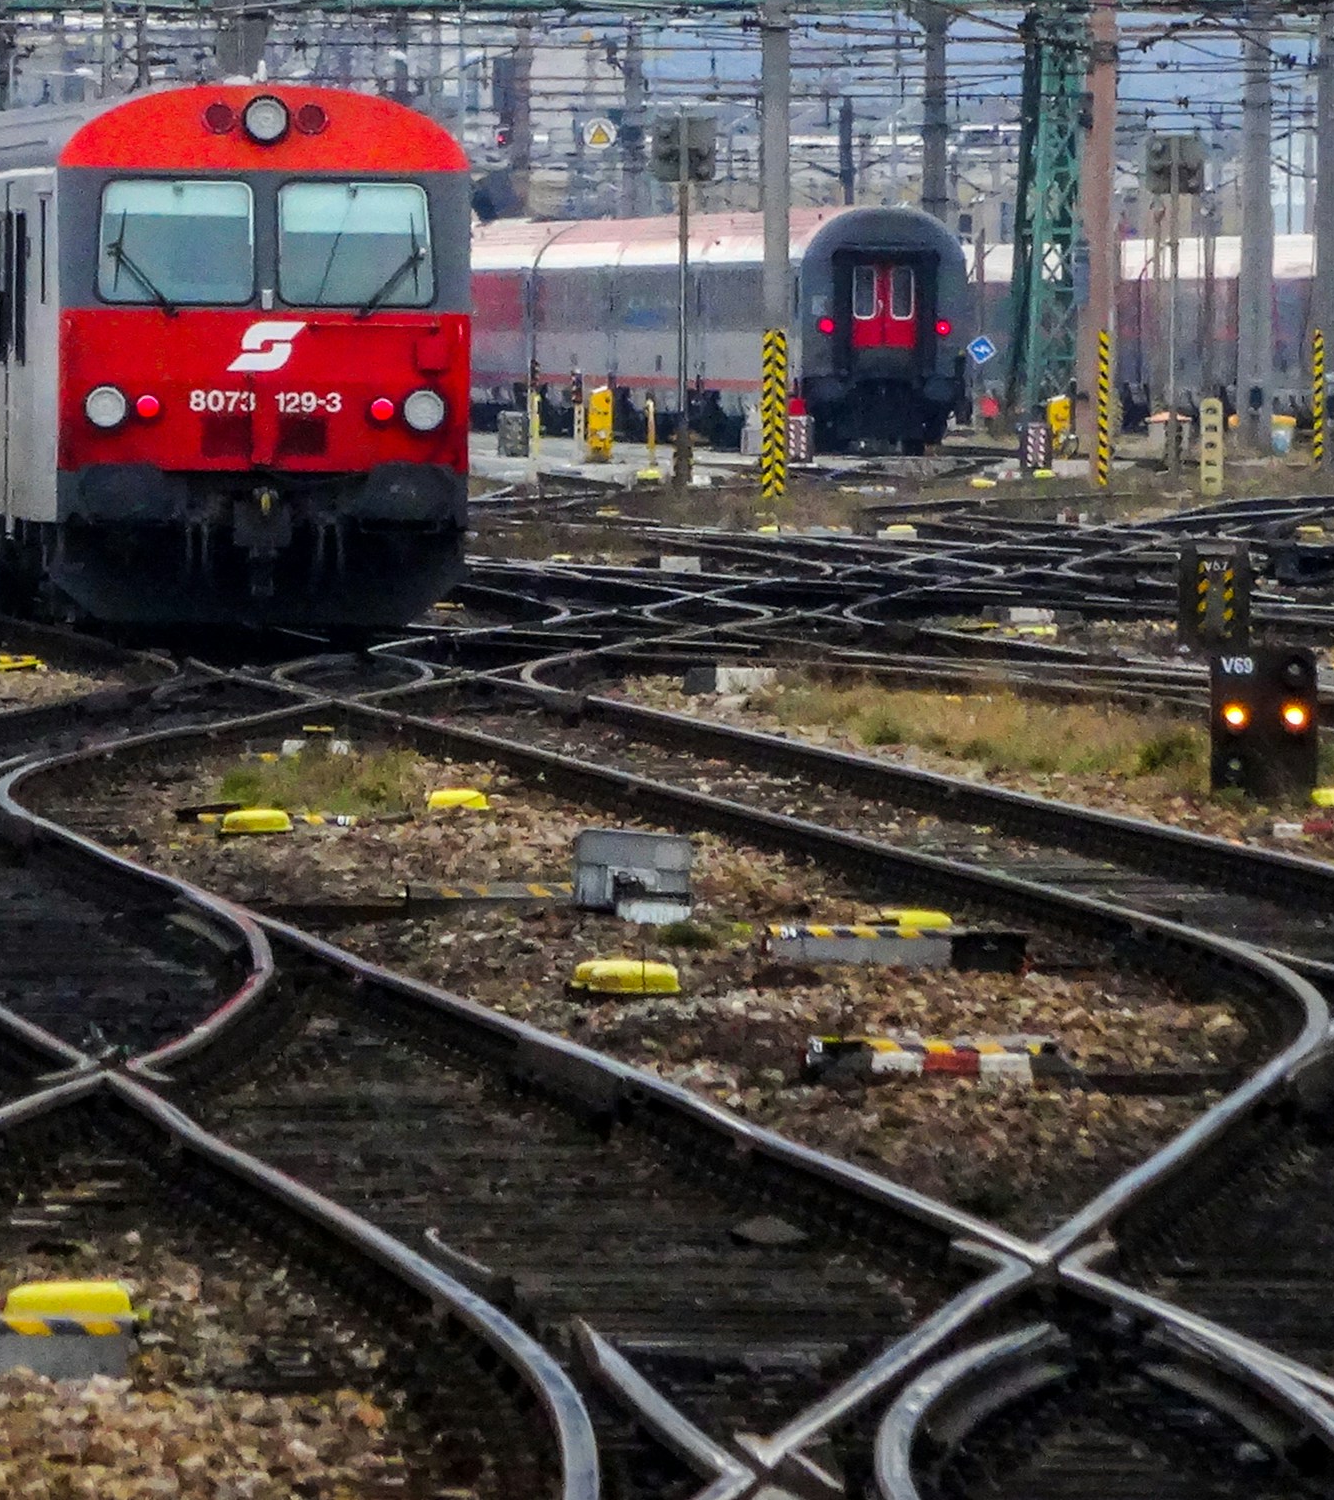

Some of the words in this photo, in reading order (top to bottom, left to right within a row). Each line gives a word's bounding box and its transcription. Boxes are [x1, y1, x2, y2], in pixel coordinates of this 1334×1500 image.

[189, 389, 256, 412] 8073
[274, 391, 343, 413] 129-3
[1220, 656, 1255, 674] V69
